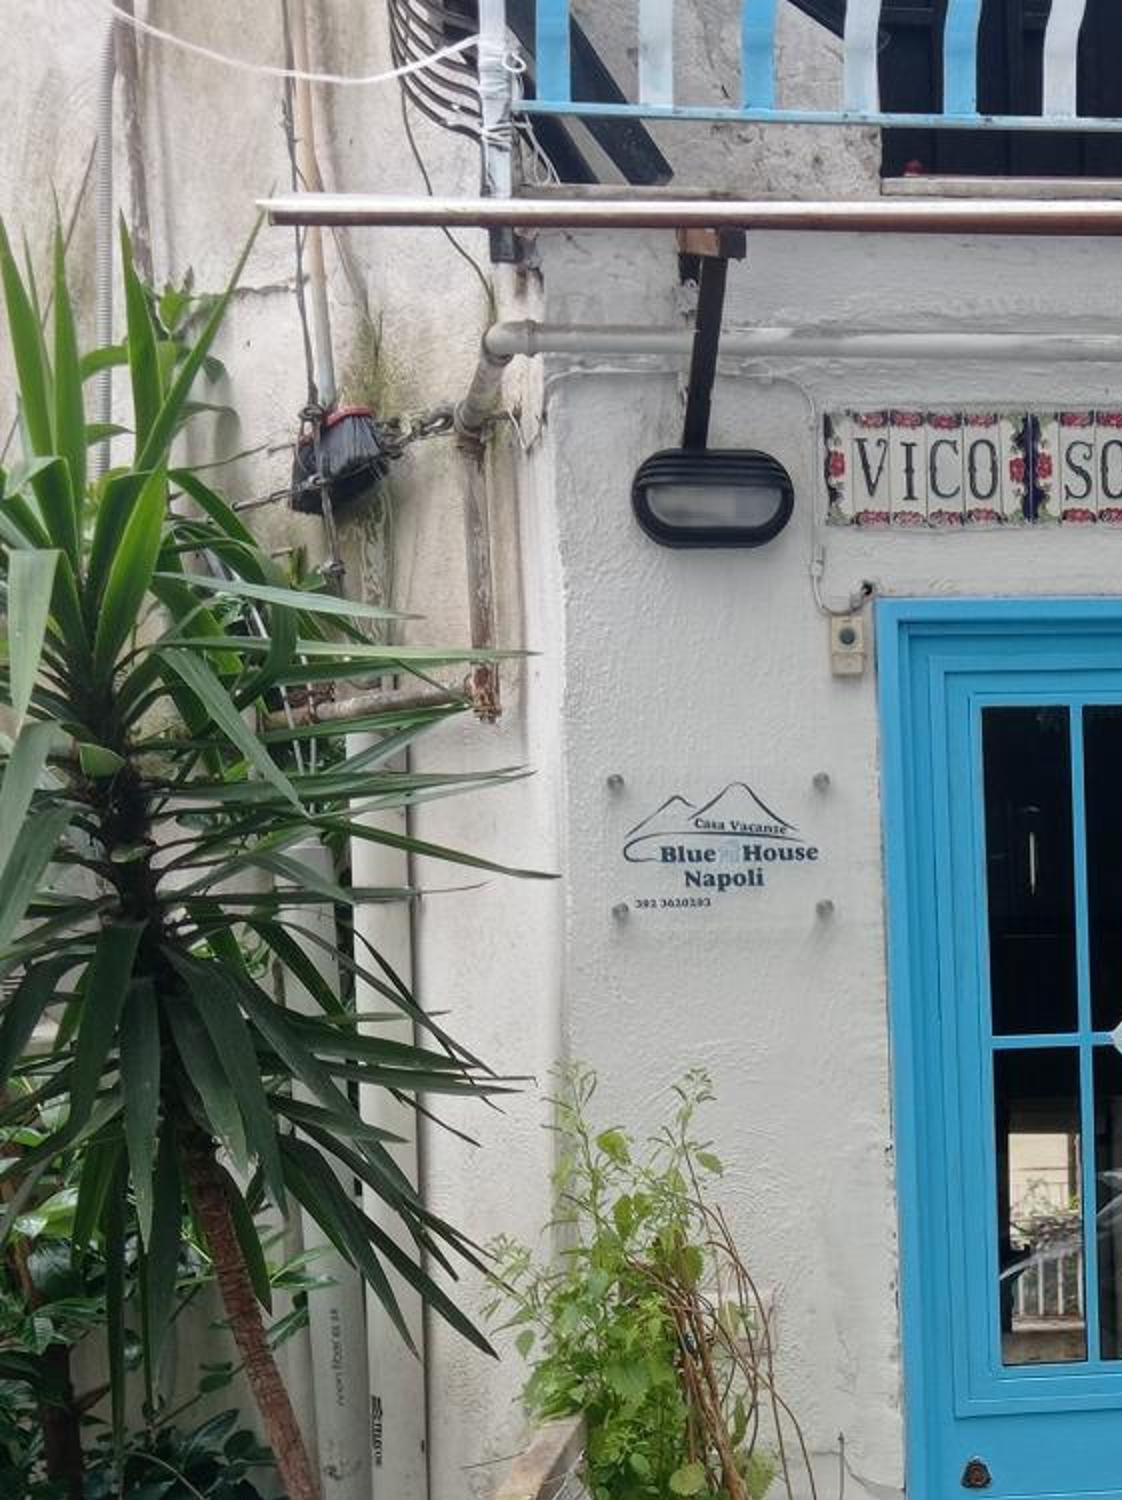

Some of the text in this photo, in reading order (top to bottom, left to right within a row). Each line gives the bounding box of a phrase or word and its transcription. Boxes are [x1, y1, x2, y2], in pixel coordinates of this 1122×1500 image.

[854, 437, 999, 501] VICO
[694, 818, 725, 830] Casa
[659, 843, 820, 863] Blue House
[684, 867, 765, 892] Napoli
